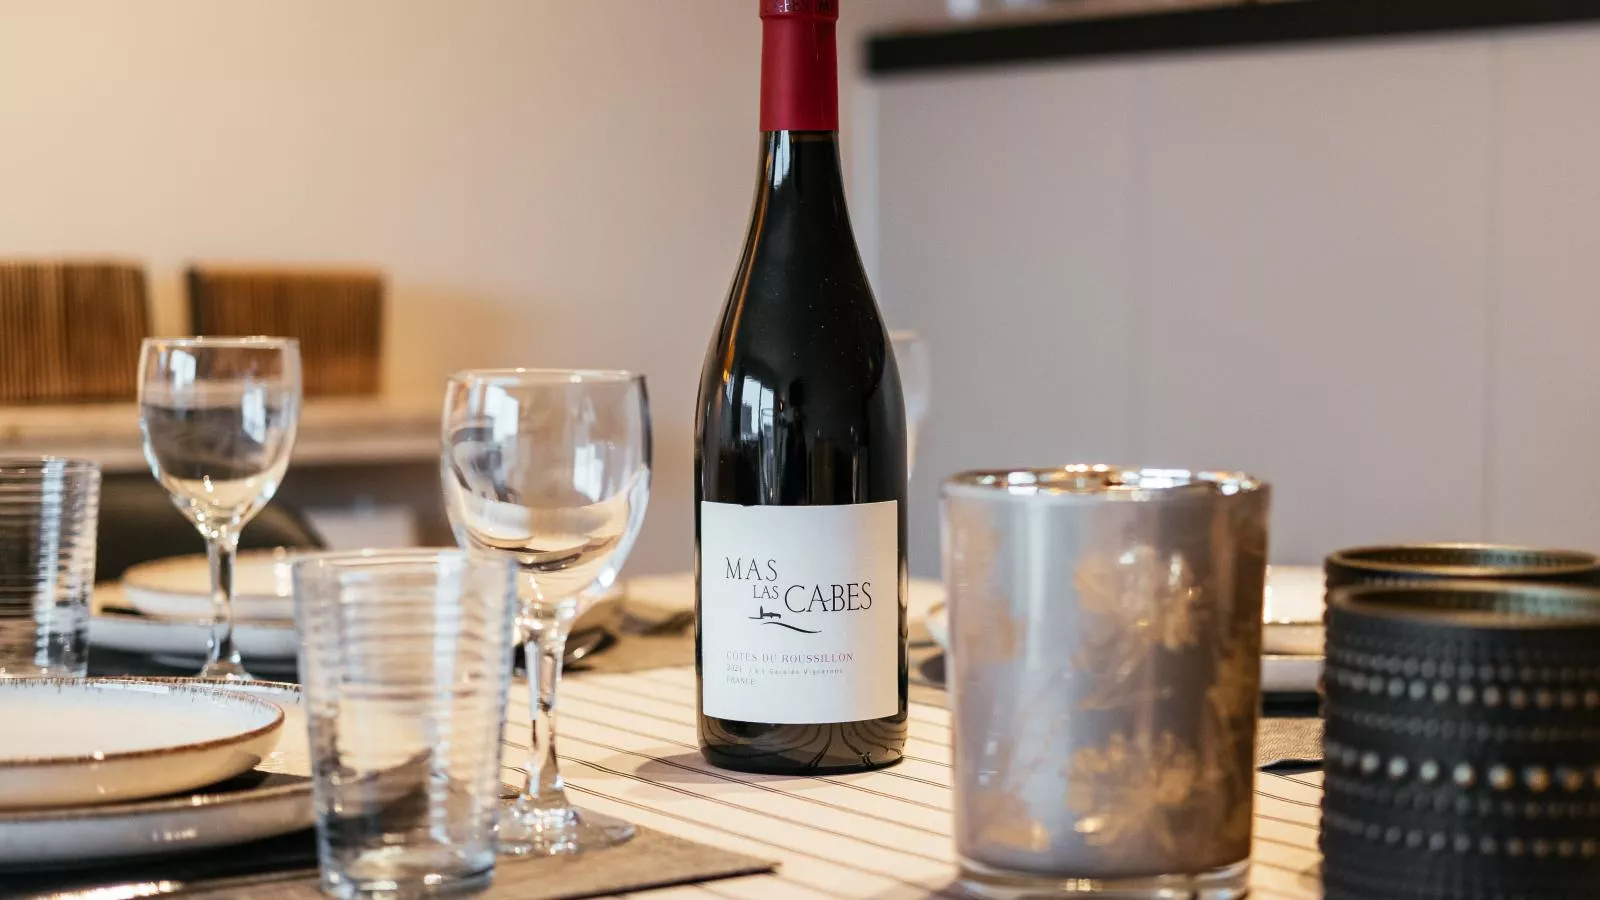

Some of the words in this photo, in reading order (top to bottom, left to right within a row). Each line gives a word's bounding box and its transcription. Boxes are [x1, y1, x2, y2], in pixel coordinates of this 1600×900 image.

[724, 556, 777, 581] MAS
[753, 584, 778, 599] LAS
[785, 582, 872, 613] CABES
[762, 652, 777, 663] DU
[782, 652, 853, 664] ROUSSILLON
[726, 675, 756, 686] FRANCE
